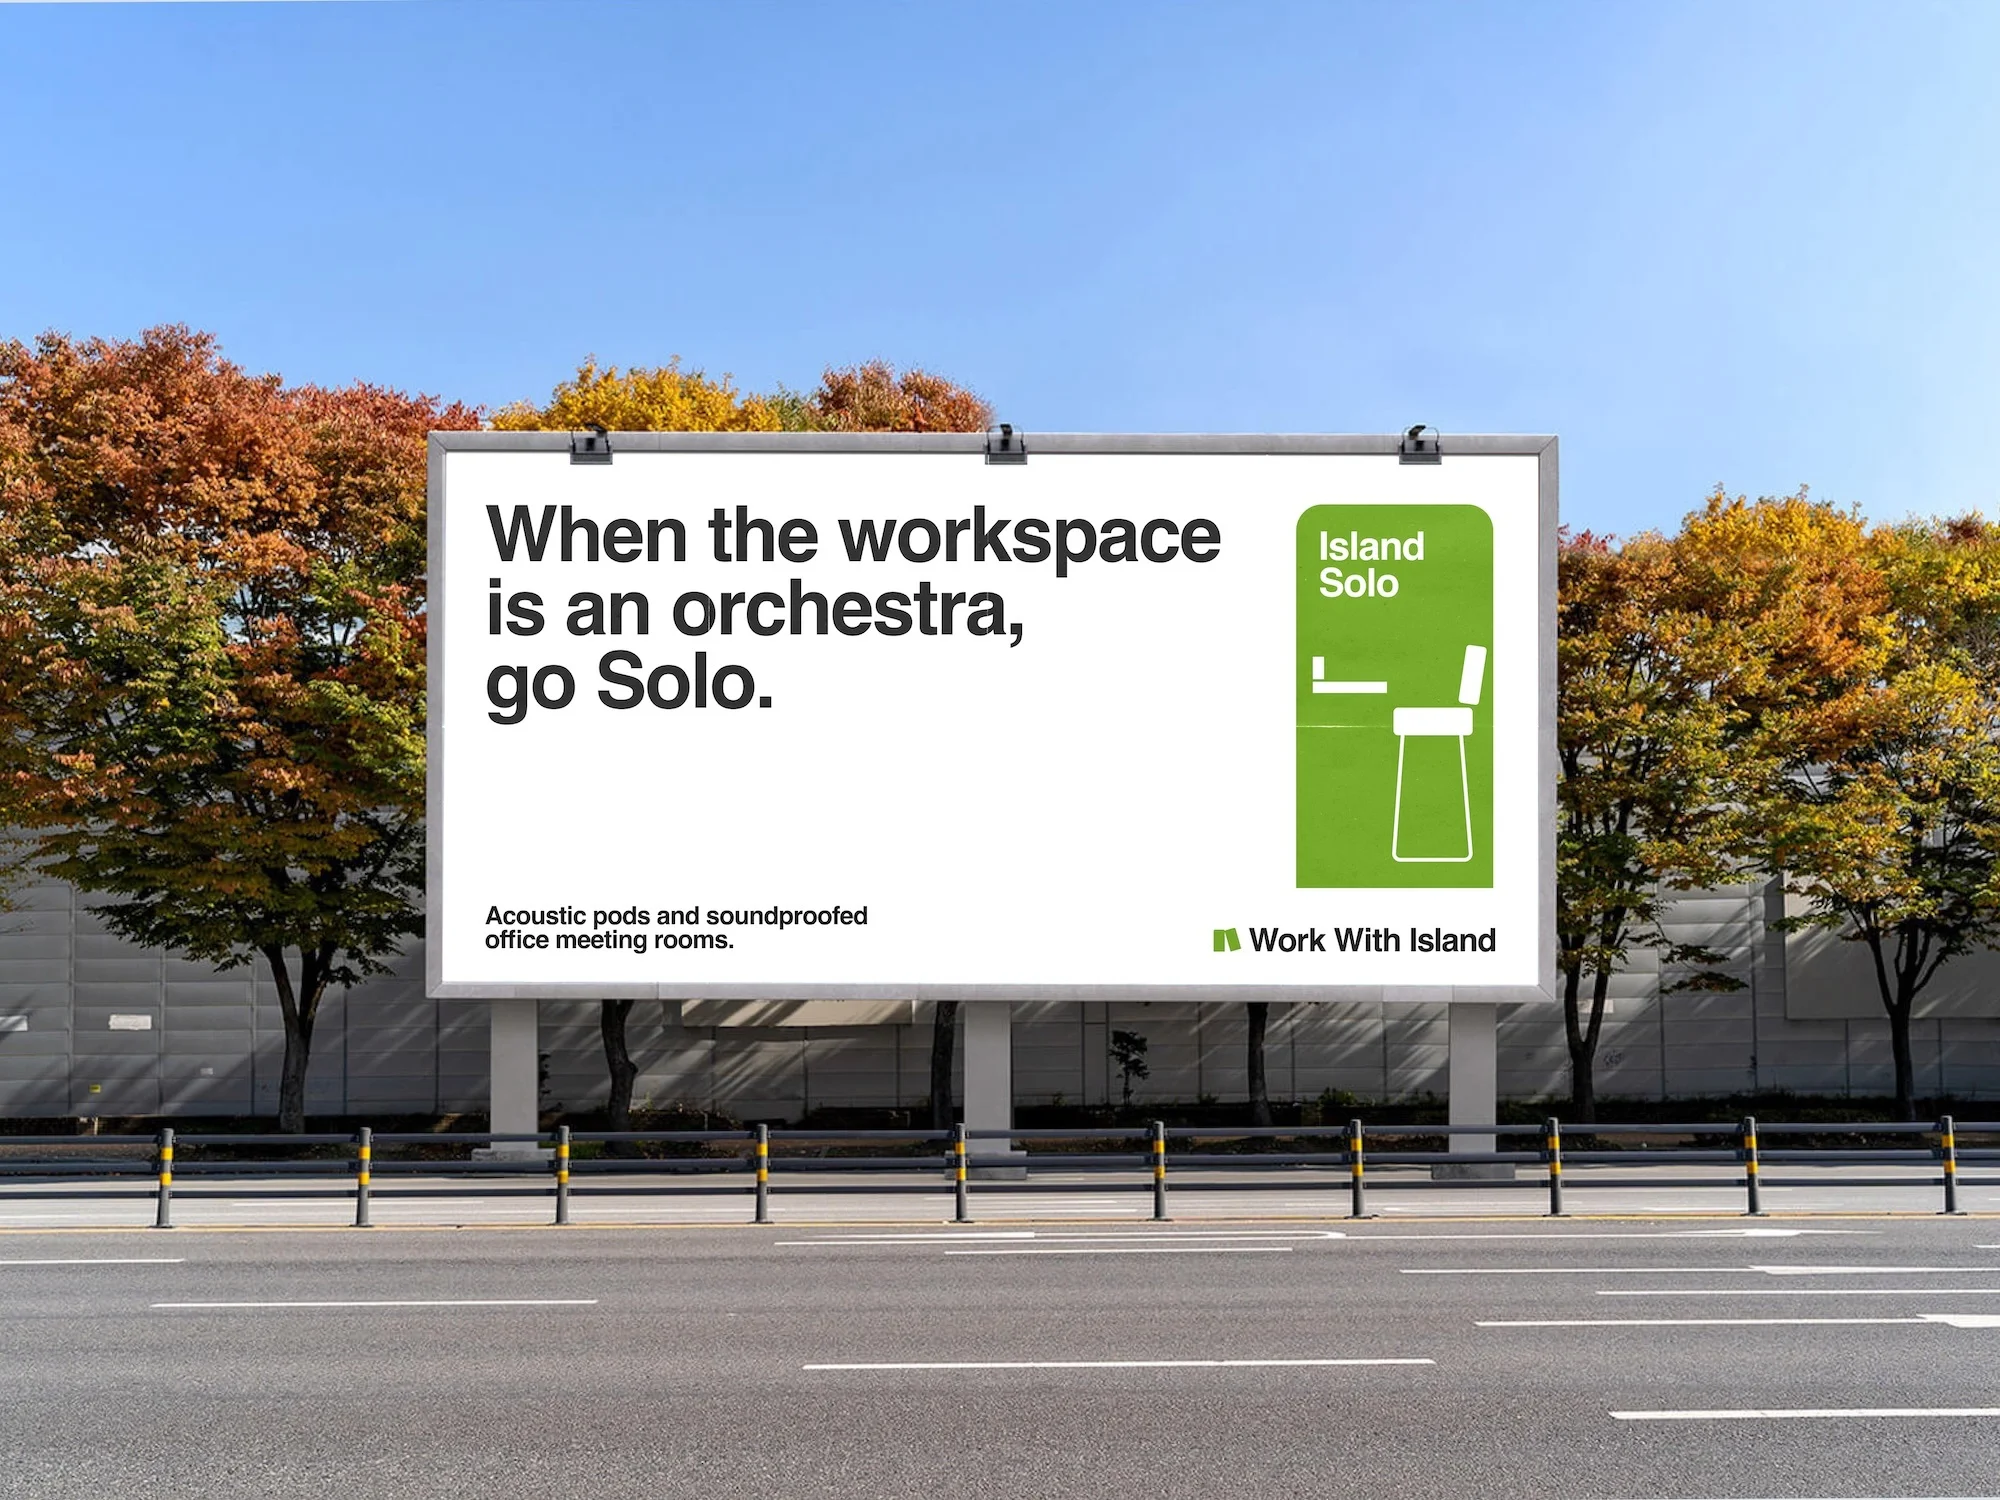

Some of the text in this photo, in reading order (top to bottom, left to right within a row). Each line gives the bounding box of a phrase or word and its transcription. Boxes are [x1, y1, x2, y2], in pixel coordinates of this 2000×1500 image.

[486, 504, 1222, 577] When the workspace
[1320, 530, 1425, 561] Island
[1319, 566, 1399, 598] Solo
[489, 578, 1024, 649] is an orchestra,
[487, 650, 772, 726] go Solo.
[485, 905, 868, 931] Acoustic pods and soundproofed
[485, 929, 734, 955] office meeting rooms.
[1248, 927, 1496, 953] Work With Island
